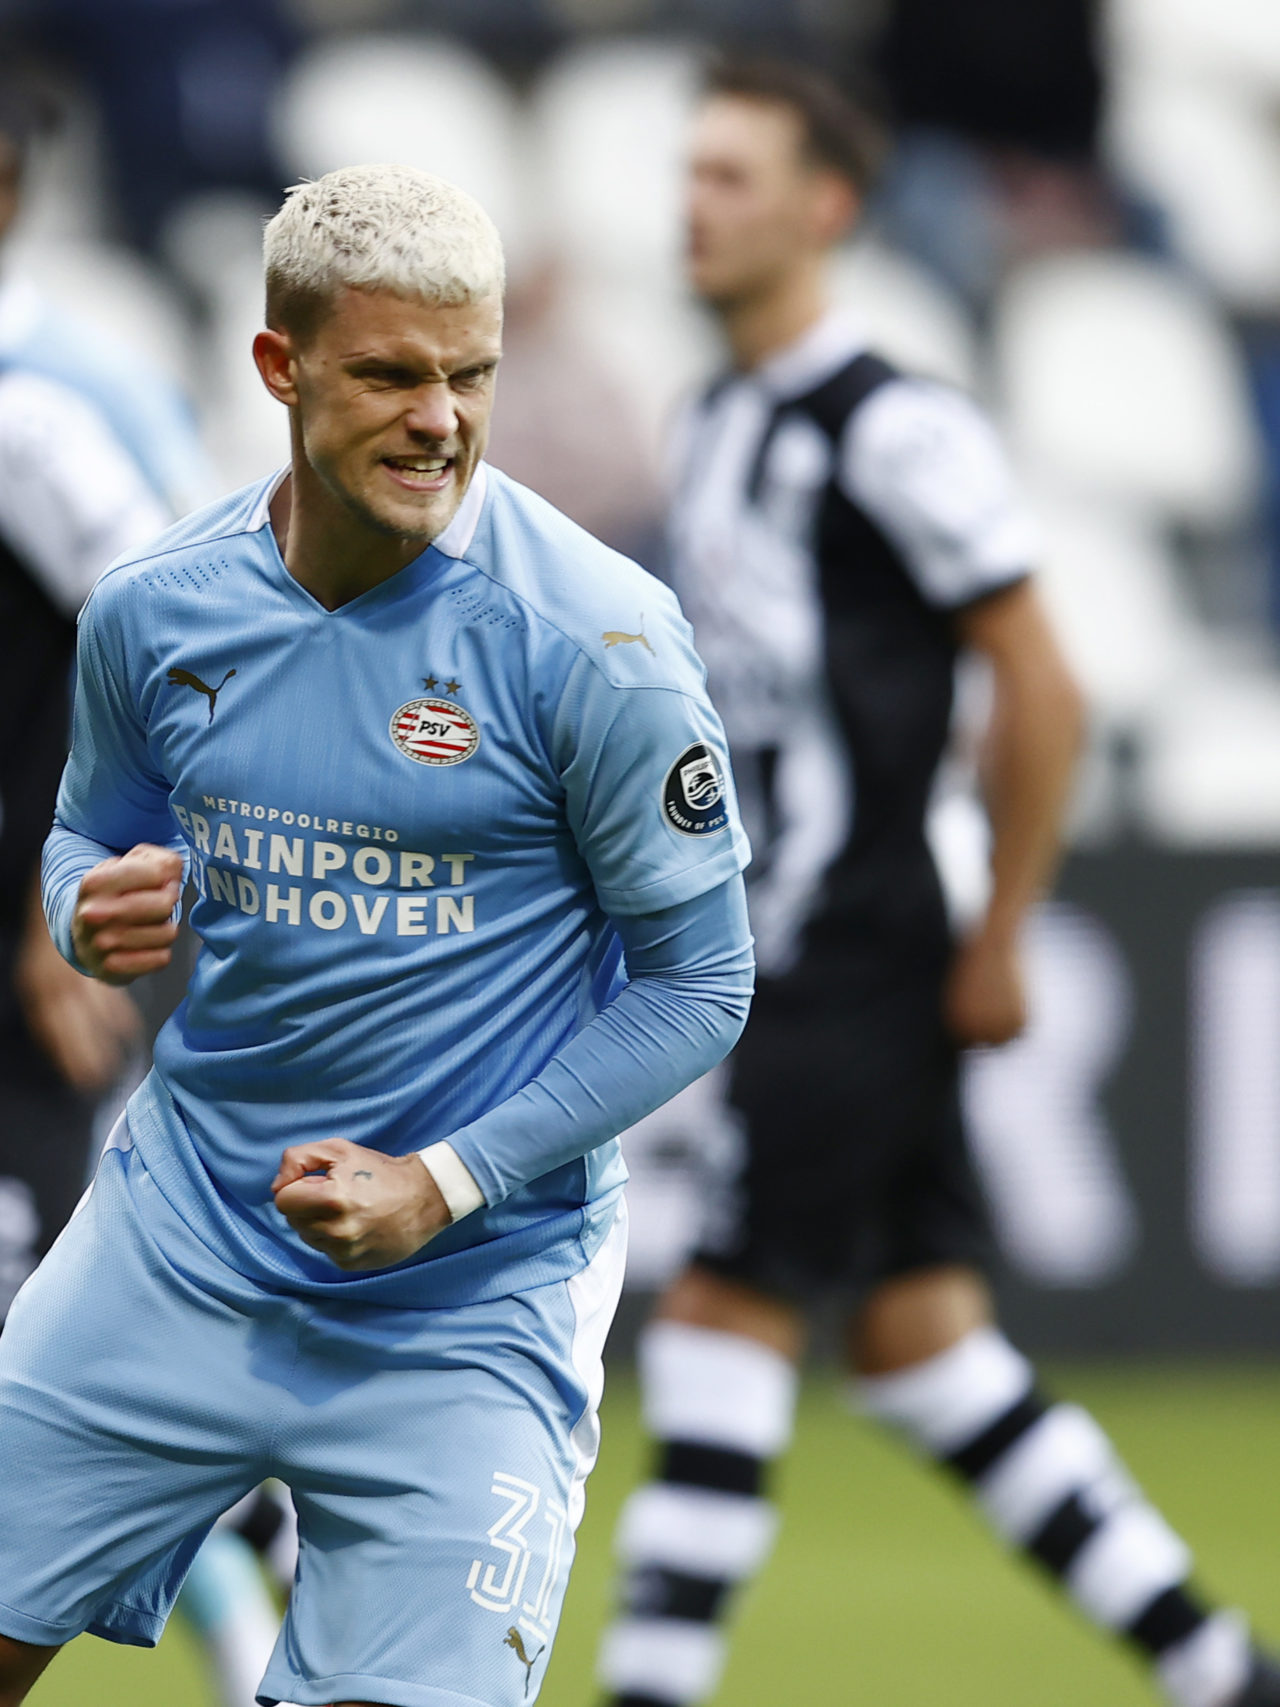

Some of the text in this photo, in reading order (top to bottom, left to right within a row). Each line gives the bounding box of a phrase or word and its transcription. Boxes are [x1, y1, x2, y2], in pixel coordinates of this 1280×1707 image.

[418, 720, 451, 737] PSV
[202, 795, 399, 842] METROPOOLREGIO
[694, 820, 706, 830] OF
[171, 803, 475, 887] BRAINPORT
[465, 1470, 568, 1643] 31
